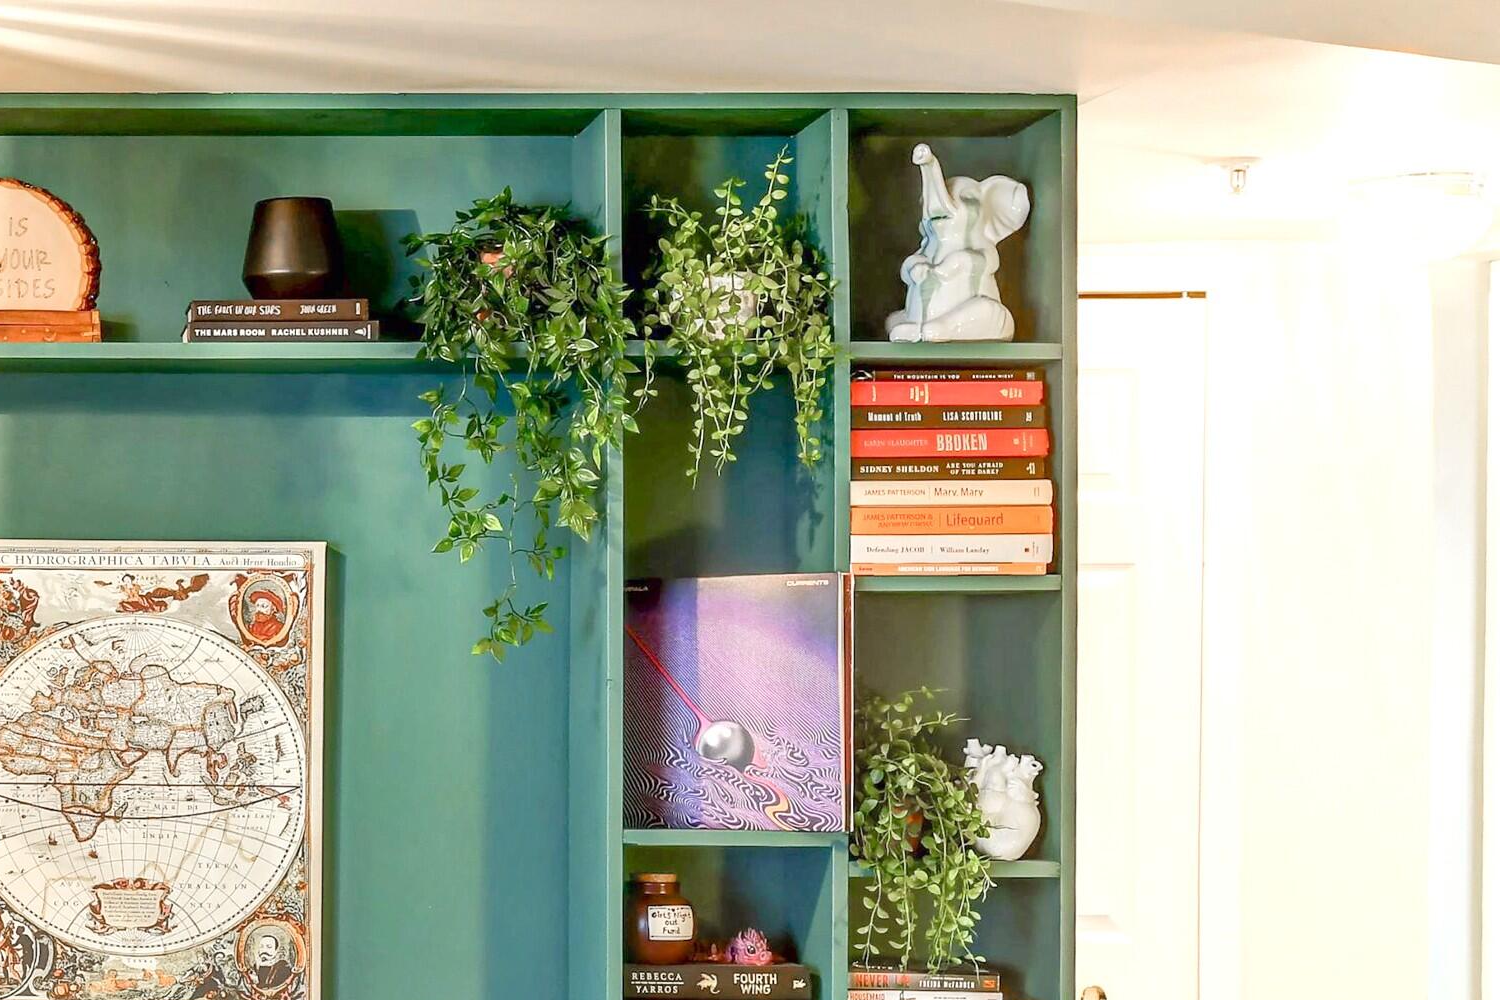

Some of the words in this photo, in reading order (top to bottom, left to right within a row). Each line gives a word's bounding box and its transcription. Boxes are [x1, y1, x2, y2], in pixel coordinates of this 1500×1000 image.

[9, 216, 29, 237] IS
[195, 329, 212, 337] THE
[213, 329, 238, 337] MARS
[308, 328, 349, 336] KUSHNER
[868, 412, 894, 422] Moment
[895, 412, 903, 421] of
[904, 412, 922, 422] Truth
[942, 412, 959, 421] LISA
[962, 412, 1003, 421] SCOTTOLINE
[936, 434, 988, 451] BROKEN
[860, 466, 893, 474] SIDNEY
[896, 465, 940, 473] SHELDON
[946, 513, 1003, 527] Lifeguard
[15, 555, 144, 566] HYDROGRAPHICA
[631, 972, 682, 982] REBECCA
[733, 973, 778, 985] FOURTH
[856, 975, 889, 987] NEVER
[636, 985, 679, 994] YARROS
[740, 984, 771, 995] WING
